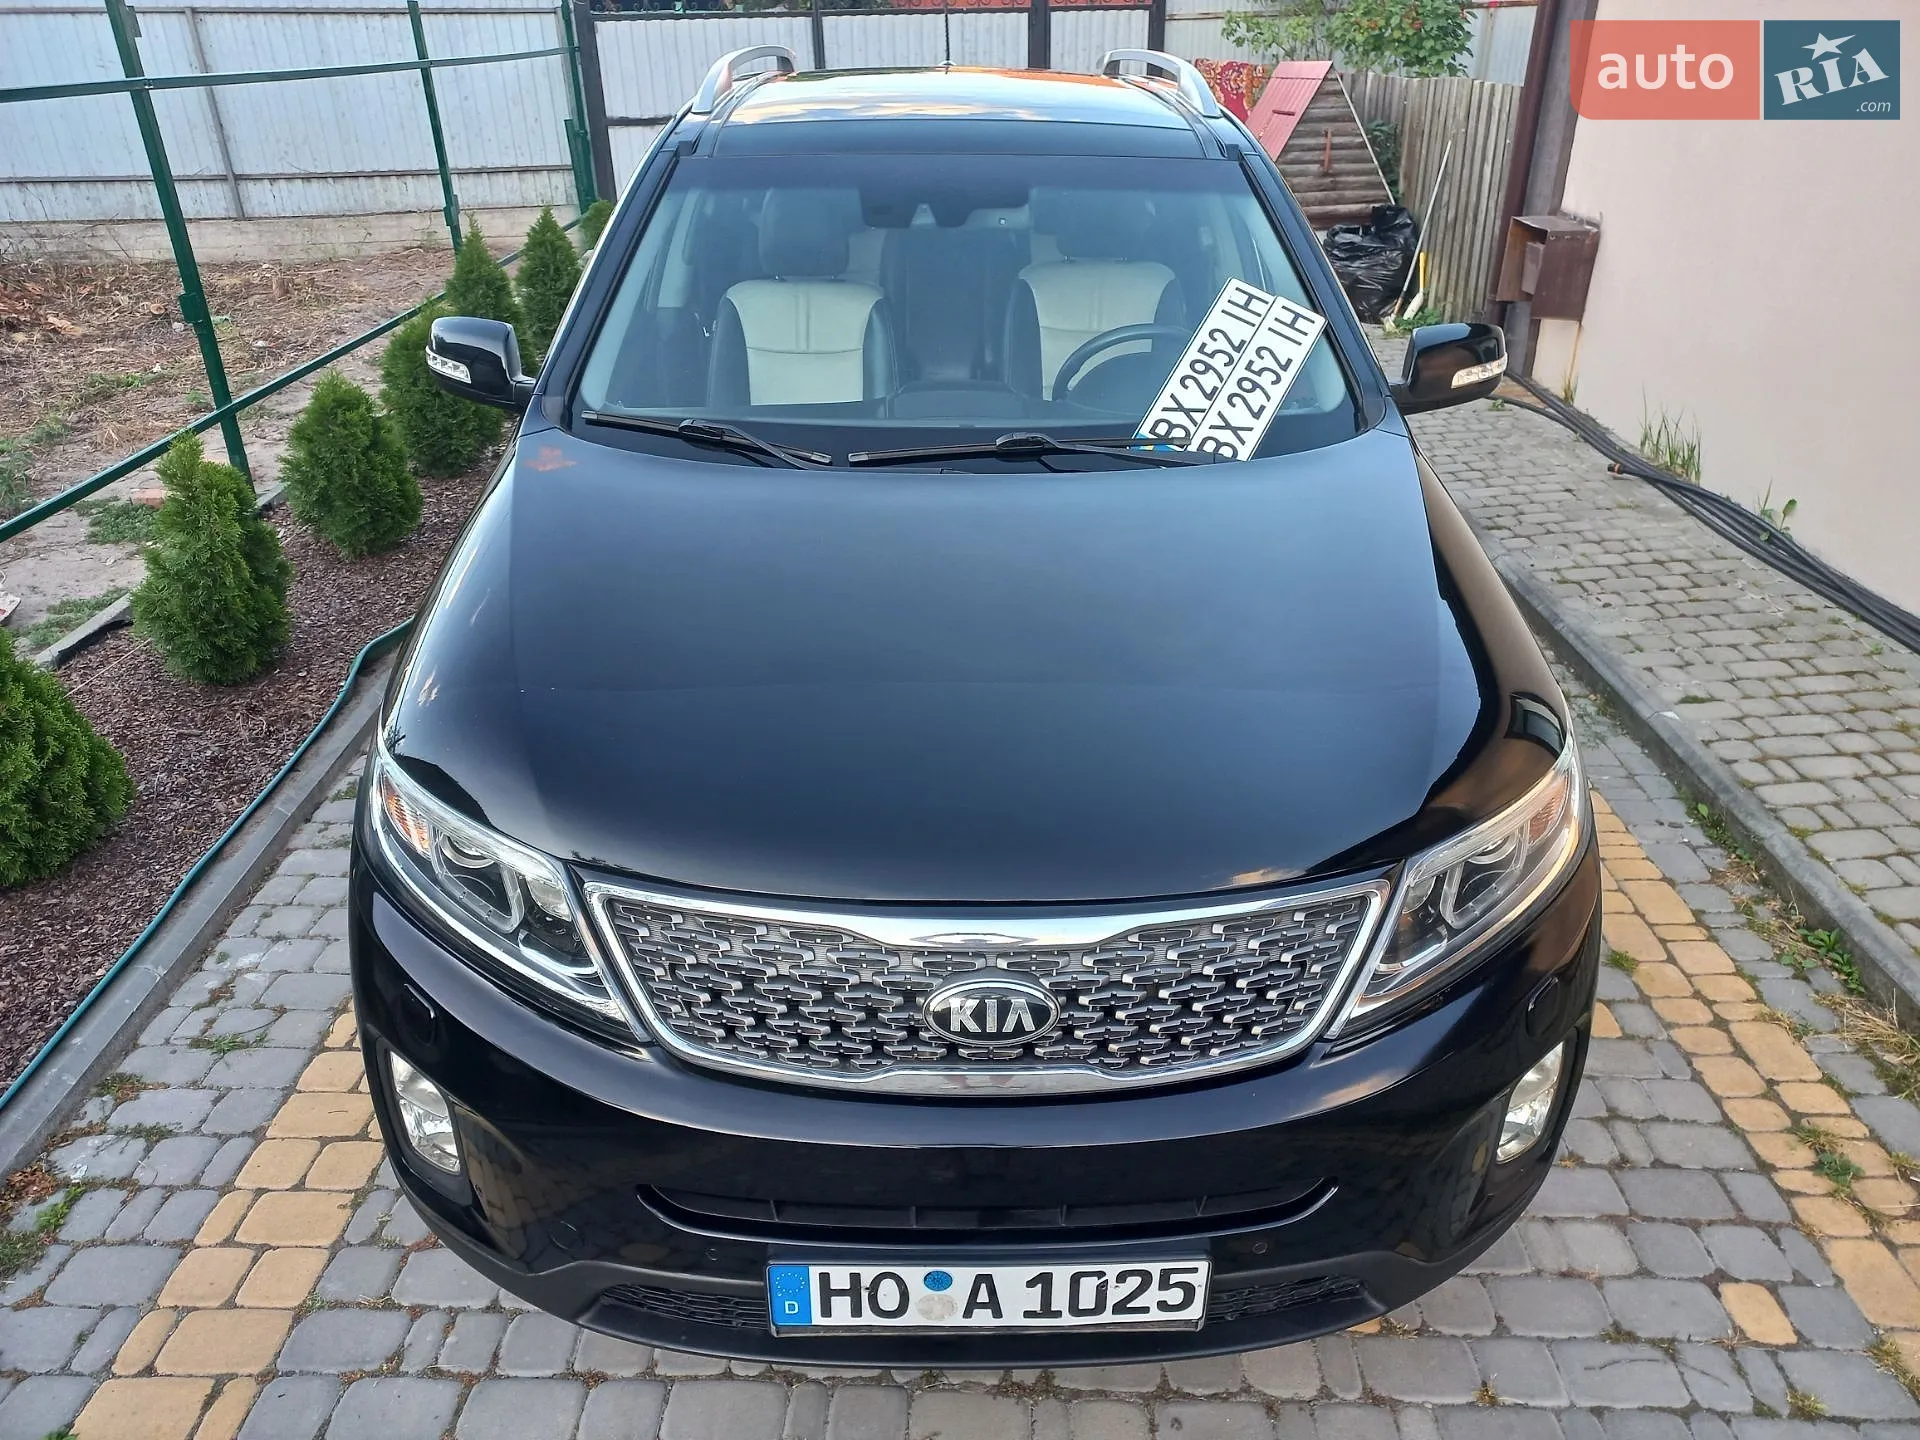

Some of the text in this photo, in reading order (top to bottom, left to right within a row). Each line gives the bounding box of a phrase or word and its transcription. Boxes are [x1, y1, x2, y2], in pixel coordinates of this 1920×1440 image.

[1148, 393, 1207, 448] BX
[1179, 328, 1247, 402] 2952
[1197, 410, 1254, 460] BX
[1227, 346, 1293, 420] 2952
[948, 997, 1036, 1033] KIA
[783, 1300, 800, 1314] D
[818, 1267, 1199, 1319] HO A 1025
